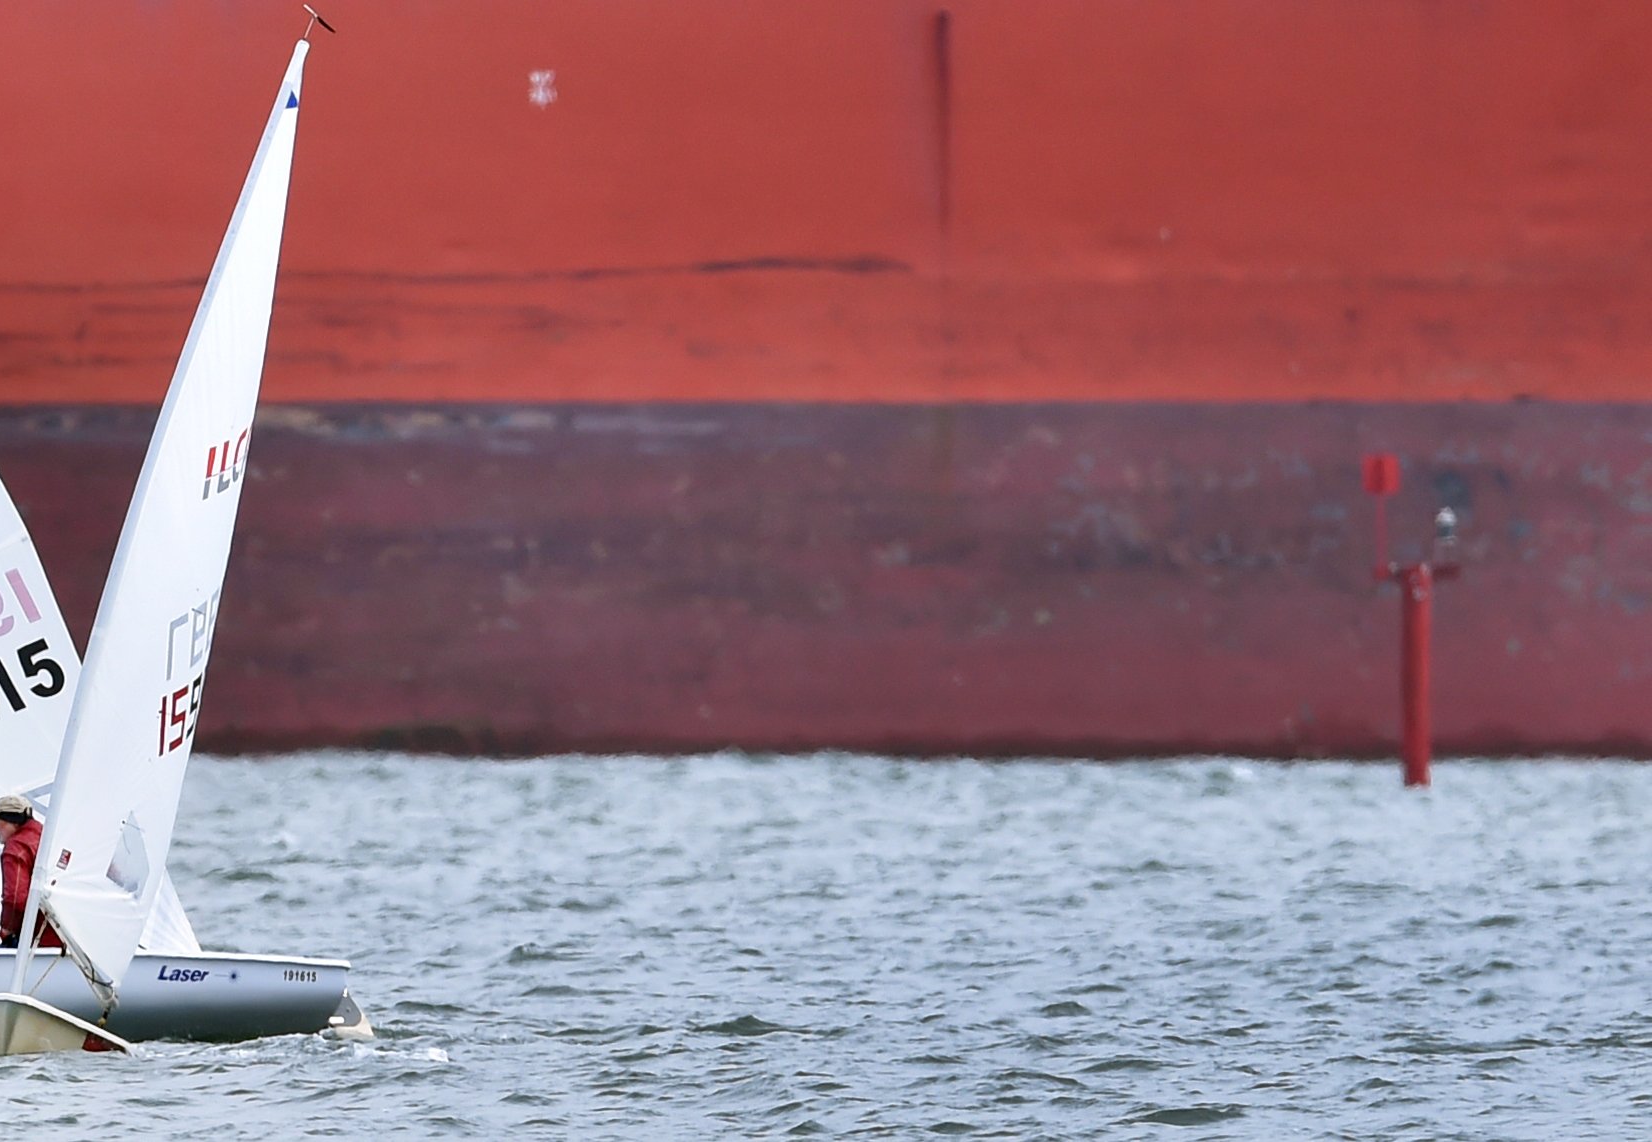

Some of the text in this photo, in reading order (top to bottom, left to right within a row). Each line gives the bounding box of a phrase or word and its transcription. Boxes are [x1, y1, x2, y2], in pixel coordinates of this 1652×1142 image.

[202, 427, 250, 500] ILC
[158, 965, 209, 982] Laser
[283, 970, 317, 982] 191615
